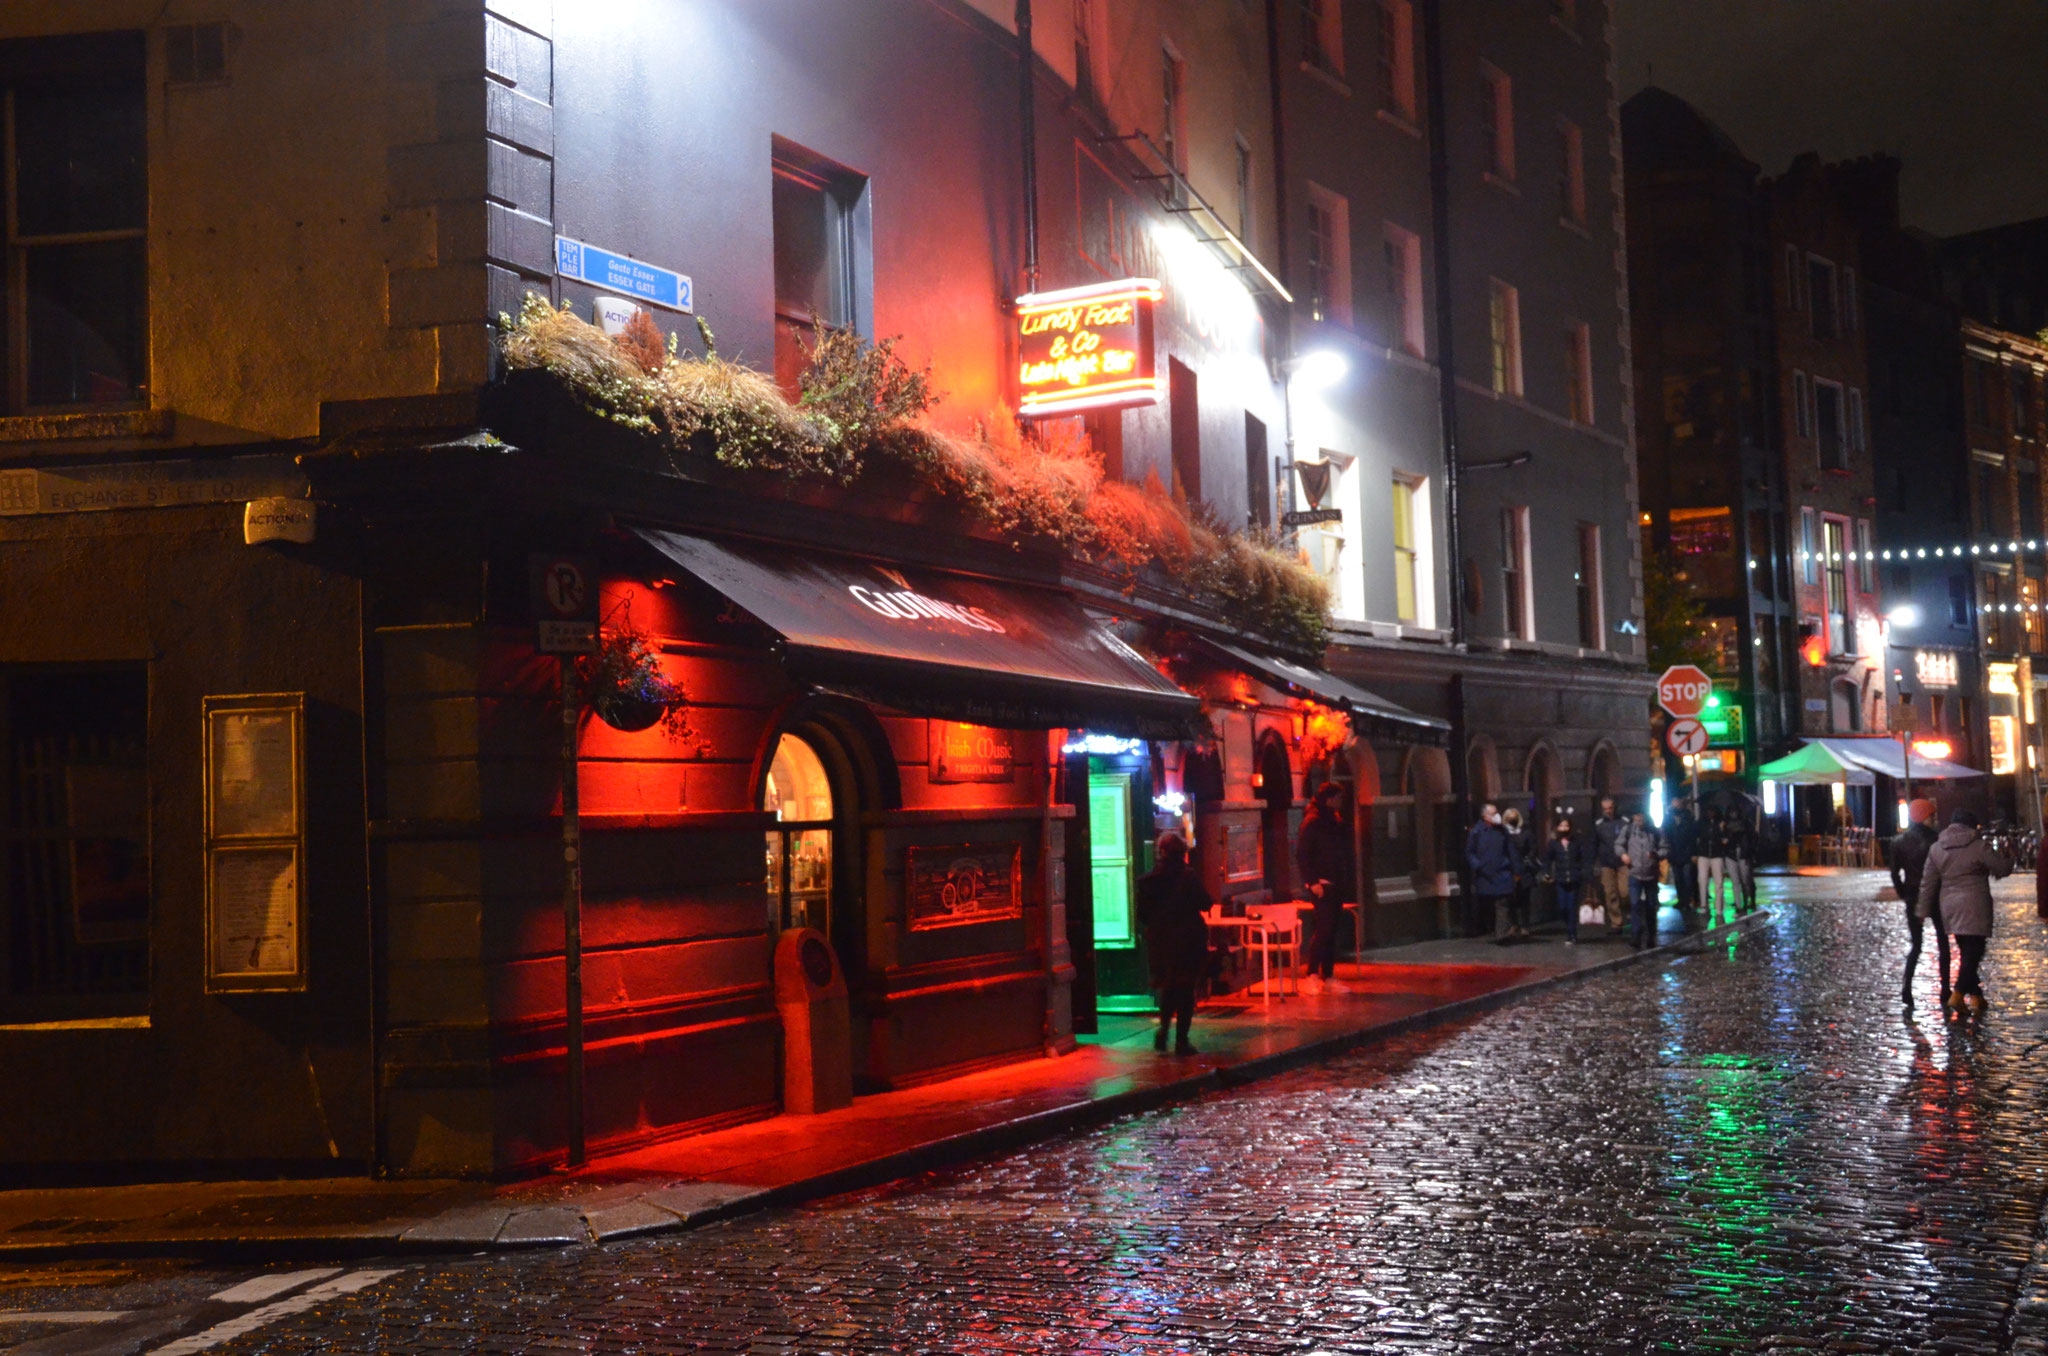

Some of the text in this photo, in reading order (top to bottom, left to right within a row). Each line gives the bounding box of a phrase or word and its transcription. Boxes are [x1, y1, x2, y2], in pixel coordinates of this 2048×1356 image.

[562, 241, 578, 254] TEM
[562, 252, 578, 265] PLE
[562, 262, 578, 275] BAR
[608, 272, 656, 295] ESSEX GATE
[632, 267, 655, 282] Essex
[679, 281, 690, 307] 2
[1021, 302, 1132, 335] Lundy Foot
[1049, 330, 1101, 358] & Co
[51, 488, 139, 508] EXCHANGE
[1288, 509, 1338, 524] GUINNESS
[848, 585, 1007, 634] GUINNESS
[1662, 682, 1708, 702] STOP
[945, 735, 1013, 759] Irish Music
